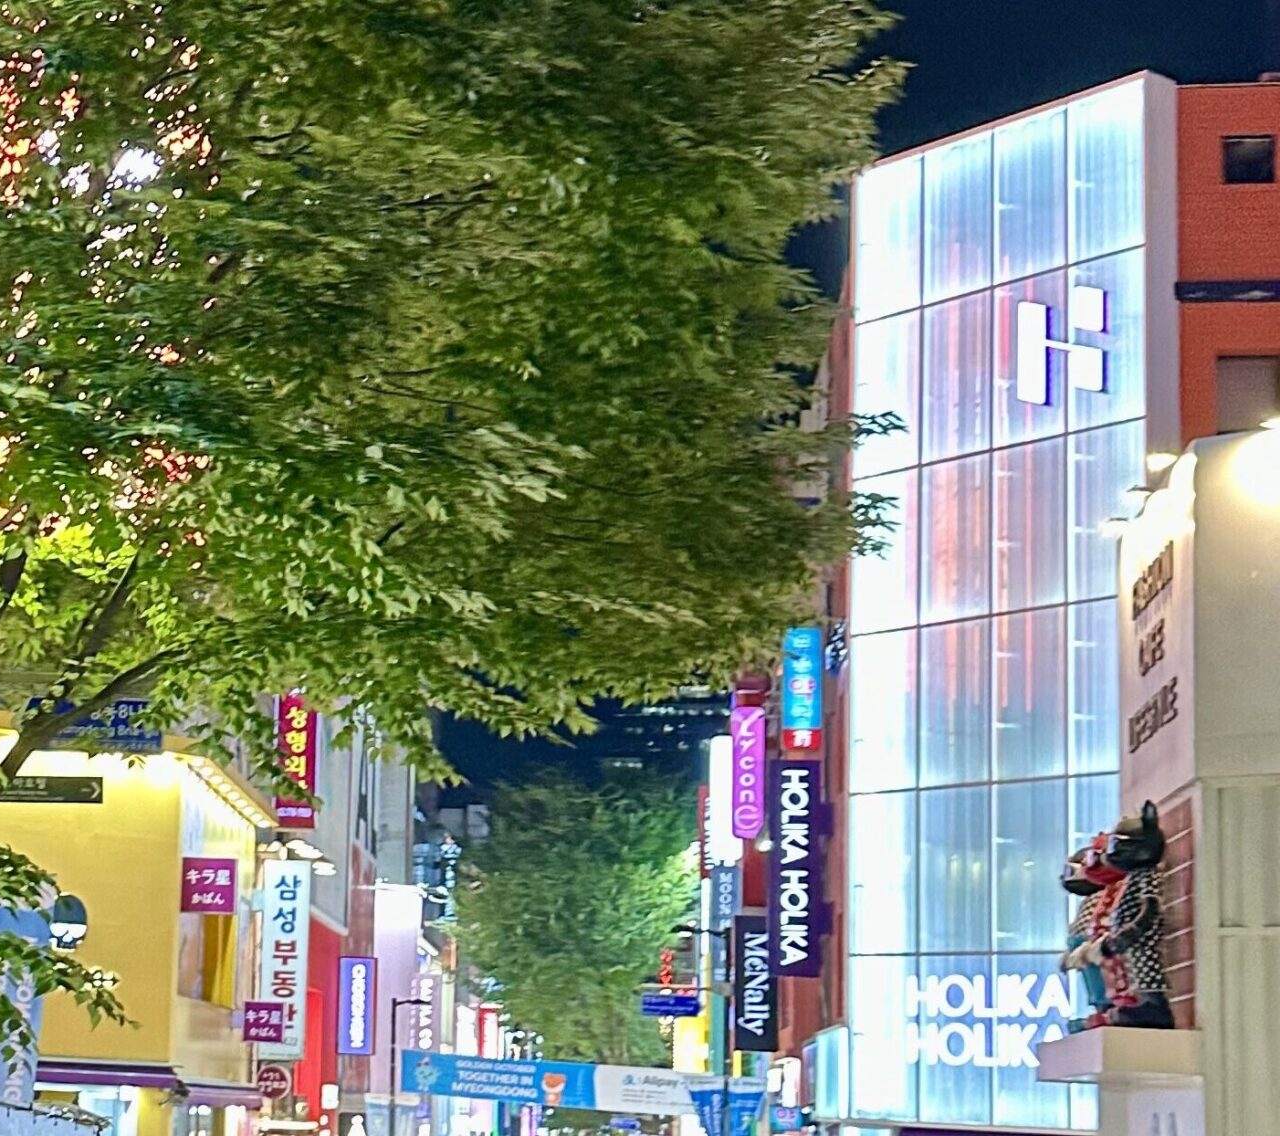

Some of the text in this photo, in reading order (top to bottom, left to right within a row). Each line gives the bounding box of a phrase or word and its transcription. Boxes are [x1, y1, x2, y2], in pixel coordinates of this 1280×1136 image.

[284, 706, 308, 791] 성형외
[780, 768, 810, 865] HOLIKA
[779, 869, 809, 967] HOLIKA
[736, 931, 771, 1037] McNally
[905, 973, 1072, 1018] HOLIKA
[451, 1082, 539, 1098] MYEONGDONG
[459, 1070, 534, 1086] TOGETHER IN
